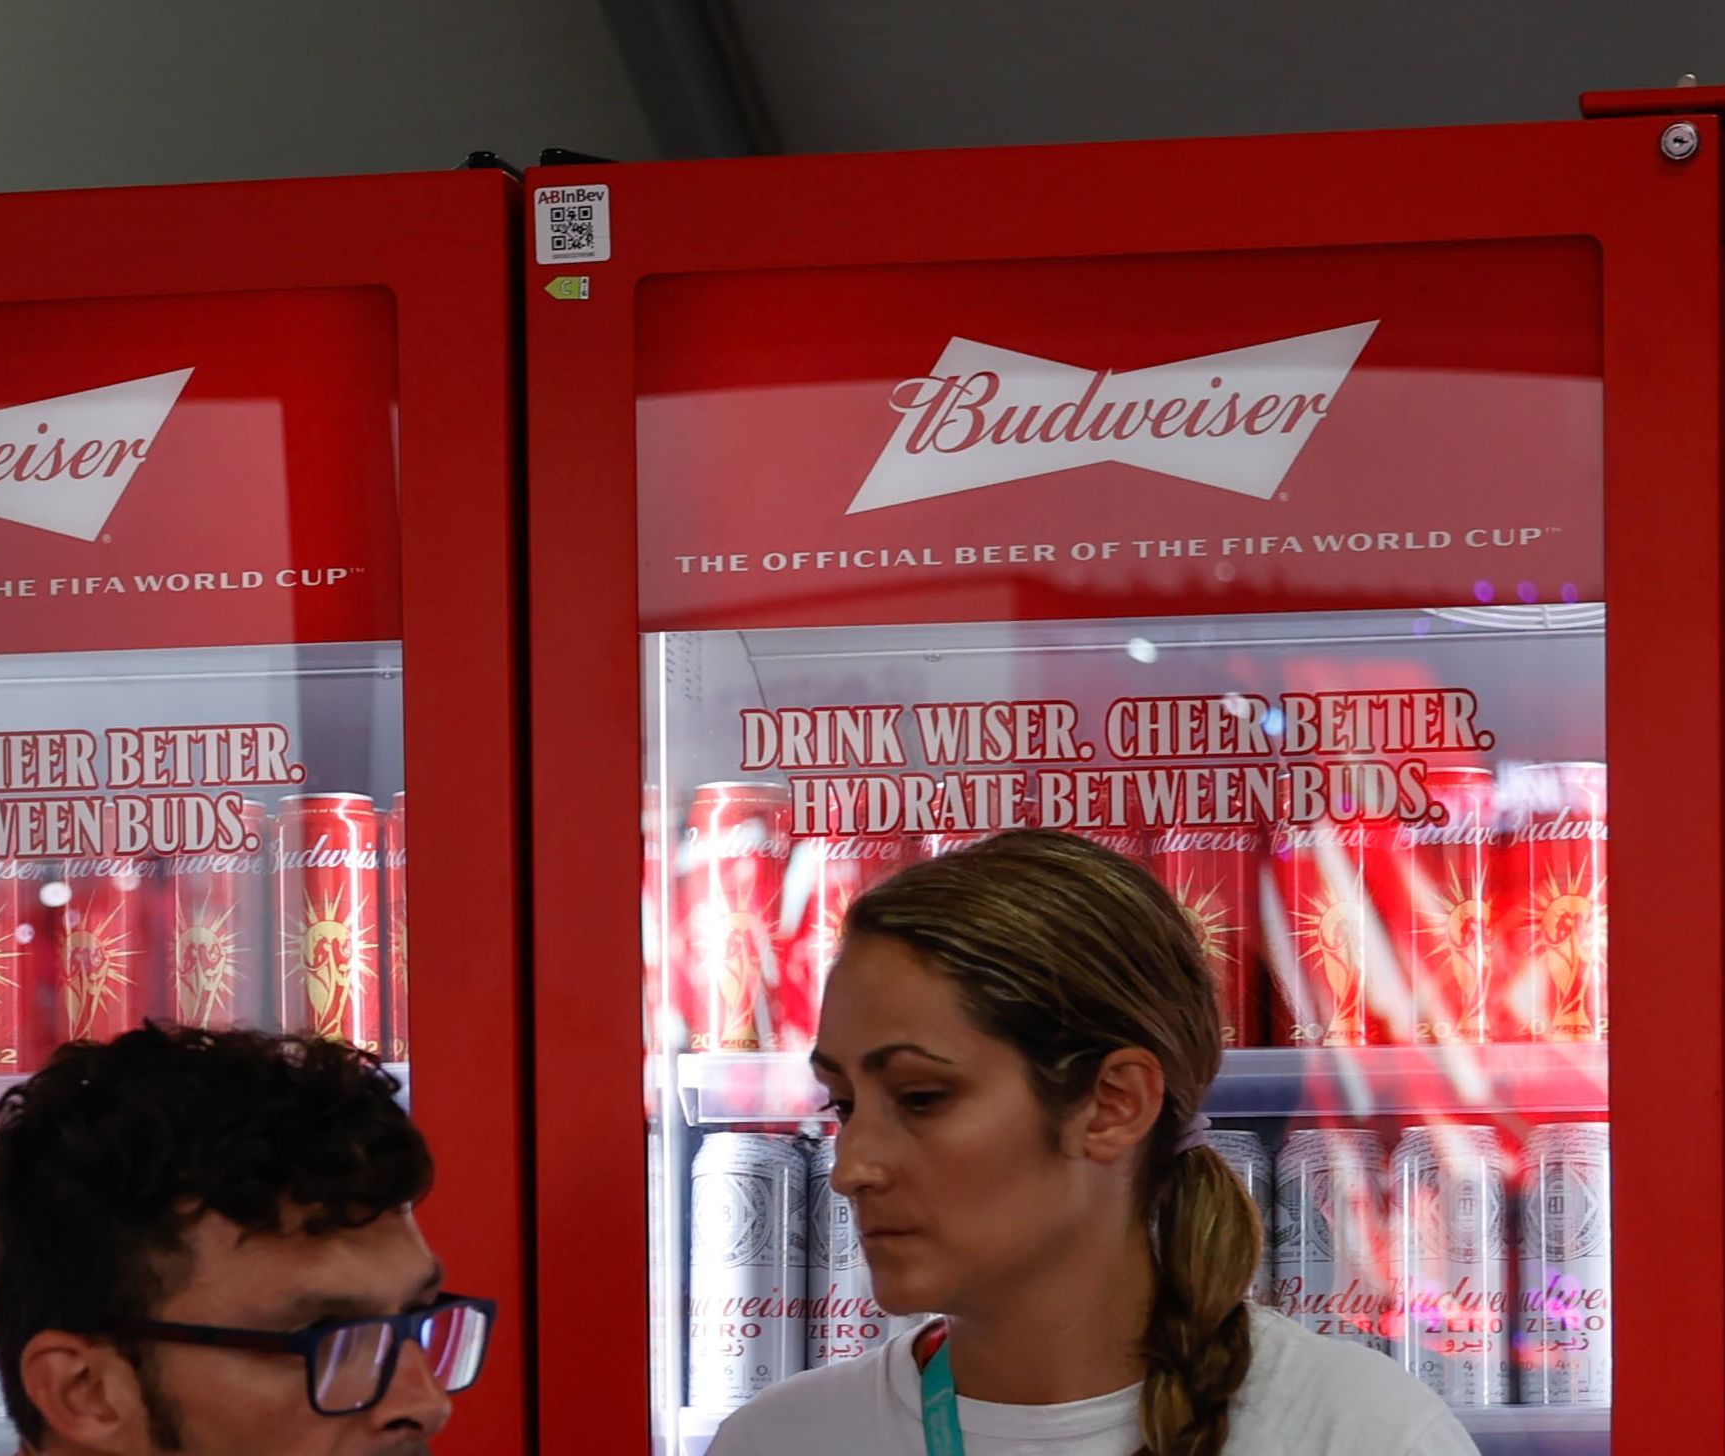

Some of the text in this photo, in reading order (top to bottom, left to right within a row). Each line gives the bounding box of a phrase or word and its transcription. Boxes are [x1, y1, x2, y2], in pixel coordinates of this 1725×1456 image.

[538, 188, 605, 204] ABInBev
[889, 367, 1330, 458] Budweiser
[49, 576, 126, 596] FIFA
[135, 569, 264, 592] WORLD
[676, 554, 751, 574] THE
[762, 545, 942, 570] OFFICIAL
[955, 541, 1058, 564] BEER
[1069, 540, 1120, 561] OF
[1133, 537, 1209, 558] THE
[1221, 534, 1305, 556] FIFA
[1312, 528, 1453, 552] WORLD
[105, 723, 307, 789] BETTER.
[740, 688, 1495, 770] DRINK WISER. CHEER BETTER.
[116, 794, 261, 856] BUDS.
[791, 761, 1444, 838] HYDRATE BETWEEN BUDS.
